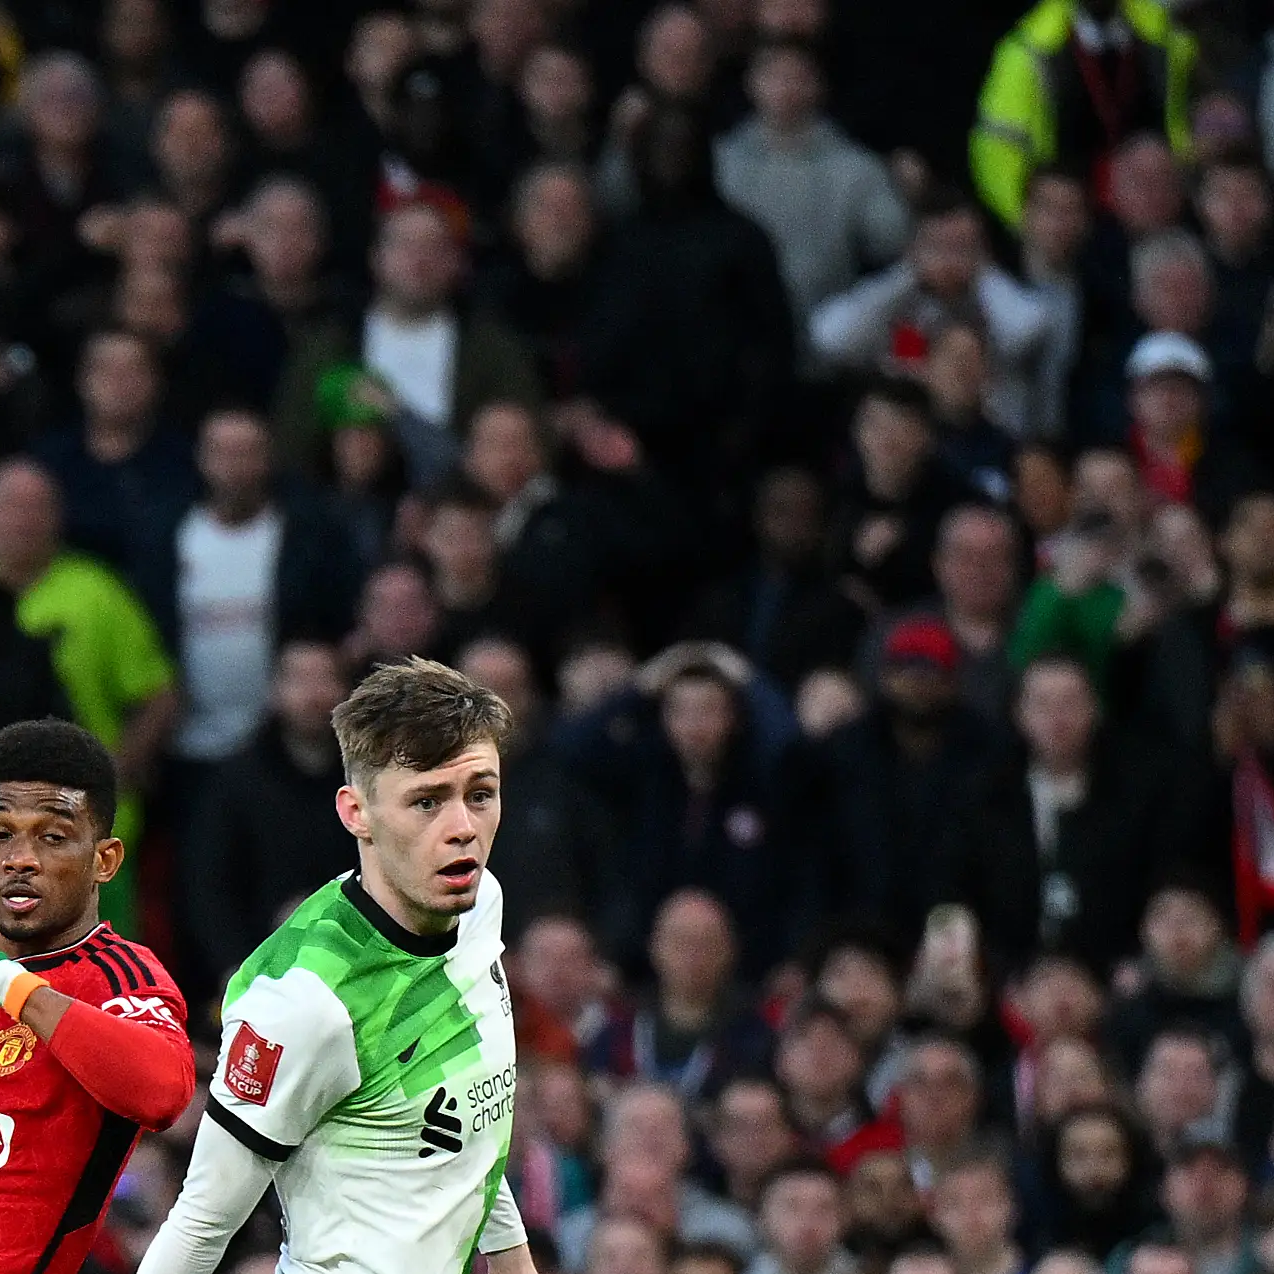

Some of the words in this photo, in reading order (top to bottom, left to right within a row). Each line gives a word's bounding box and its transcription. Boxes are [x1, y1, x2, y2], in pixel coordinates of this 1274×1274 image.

[228, 1072, 238, 1087] FA
[237, 1081, 262, 1096] CUP
[472, 1091, 516, 1132] chart
